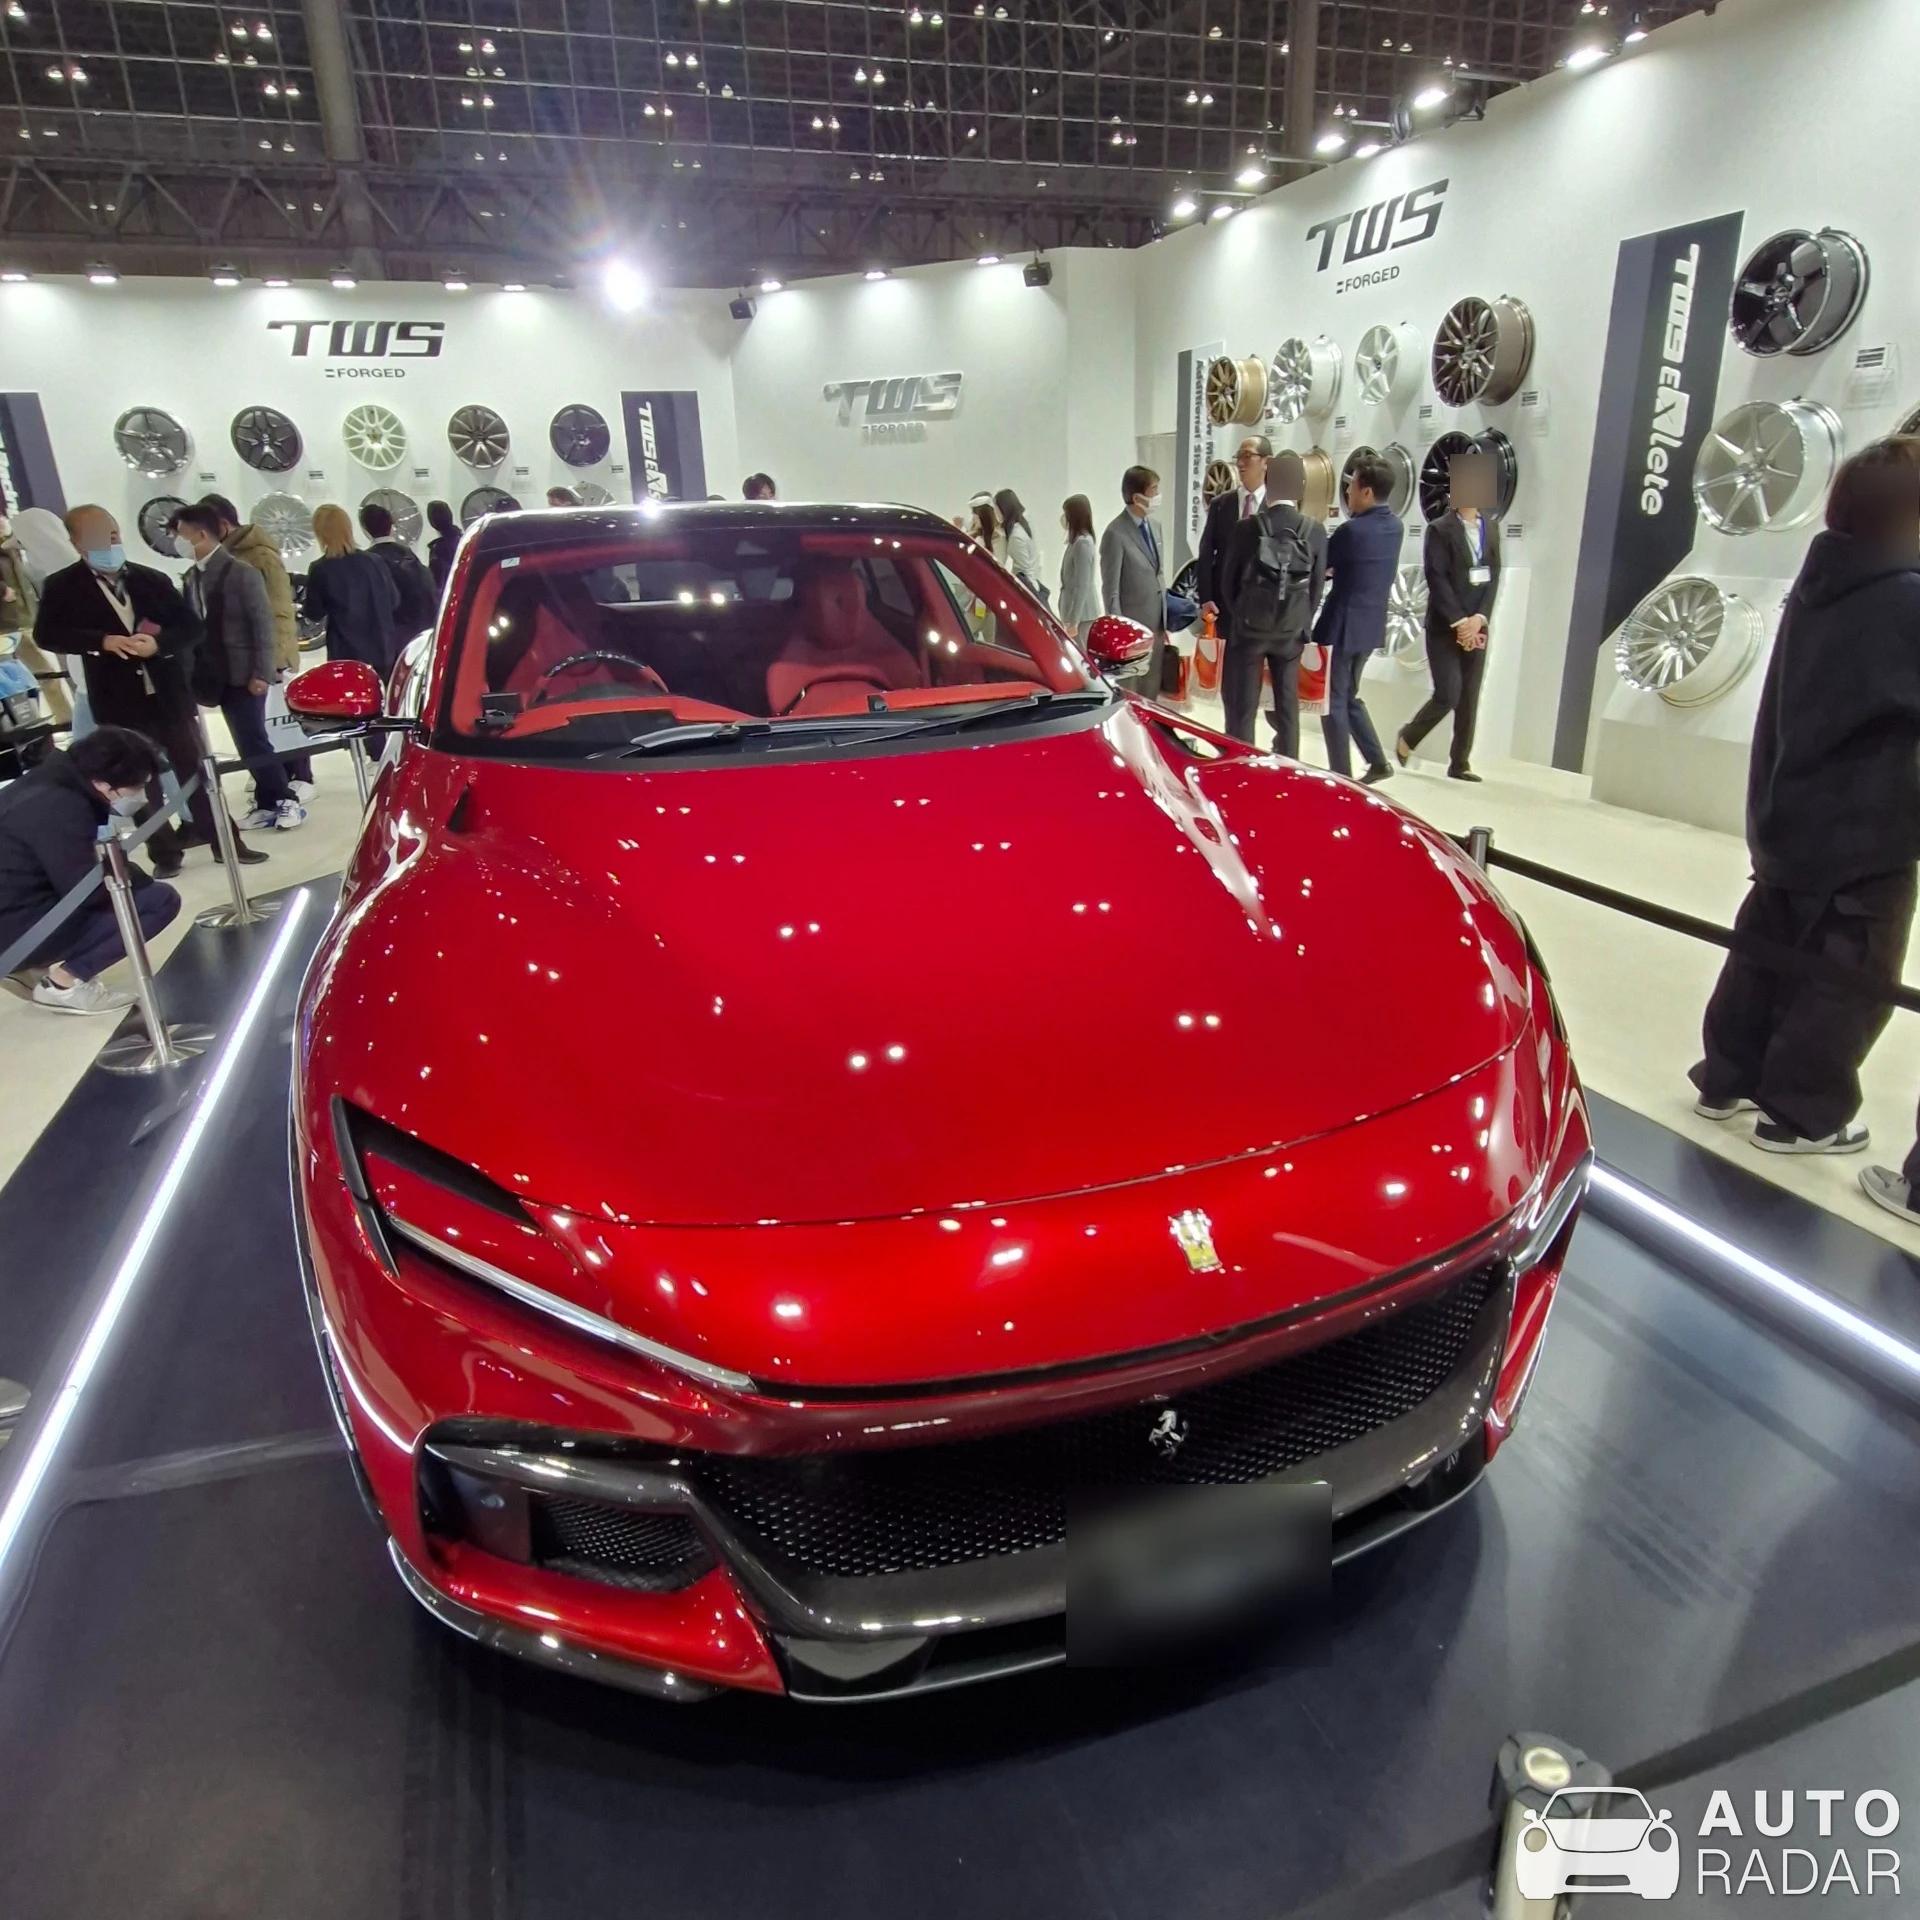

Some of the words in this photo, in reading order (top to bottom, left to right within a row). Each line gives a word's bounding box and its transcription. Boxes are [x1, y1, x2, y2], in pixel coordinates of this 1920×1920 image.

[1306, 178, 1449, 273] TWS
[1345, 265, 1401, 293] FORGED
[1662, 243, 1700, 364] TWS
[266, 320, 446, 358] TWS
[337, 368, 406, 379] FORGED
[823, 371, 964, 420] TWS
[638, 401, 658, 460] TWS
[266, 714, 299, 727] TW
